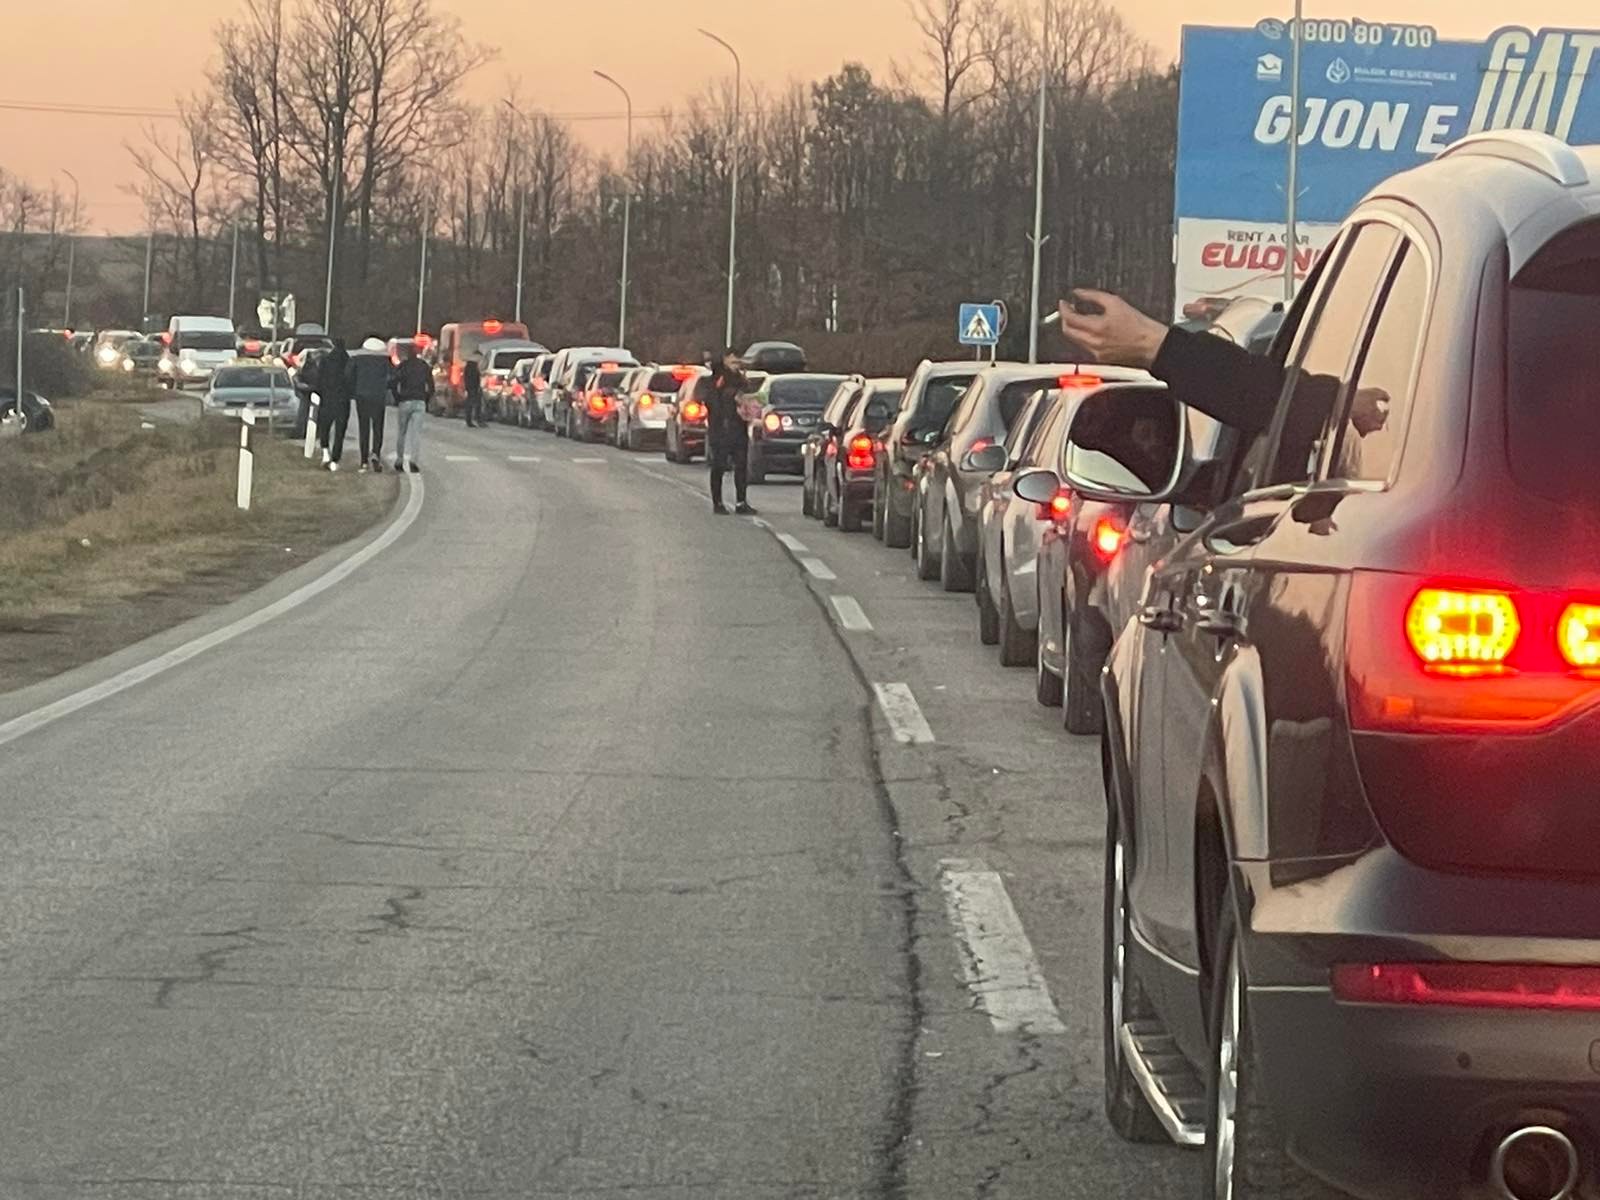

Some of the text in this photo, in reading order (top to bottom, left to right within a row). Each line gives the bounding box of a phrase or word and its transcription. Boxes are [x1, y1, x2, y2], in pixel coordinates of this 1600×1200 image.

[1354, 25, 1383, 45] 80
[1391, 27, 1432, 48] 700
[1254, 95, 1410, 151] GJON
[1415, 105, 1459, 153] E
[1227, 230, 1263, 242] RENT
[1267, 232, 1277, 243] A
